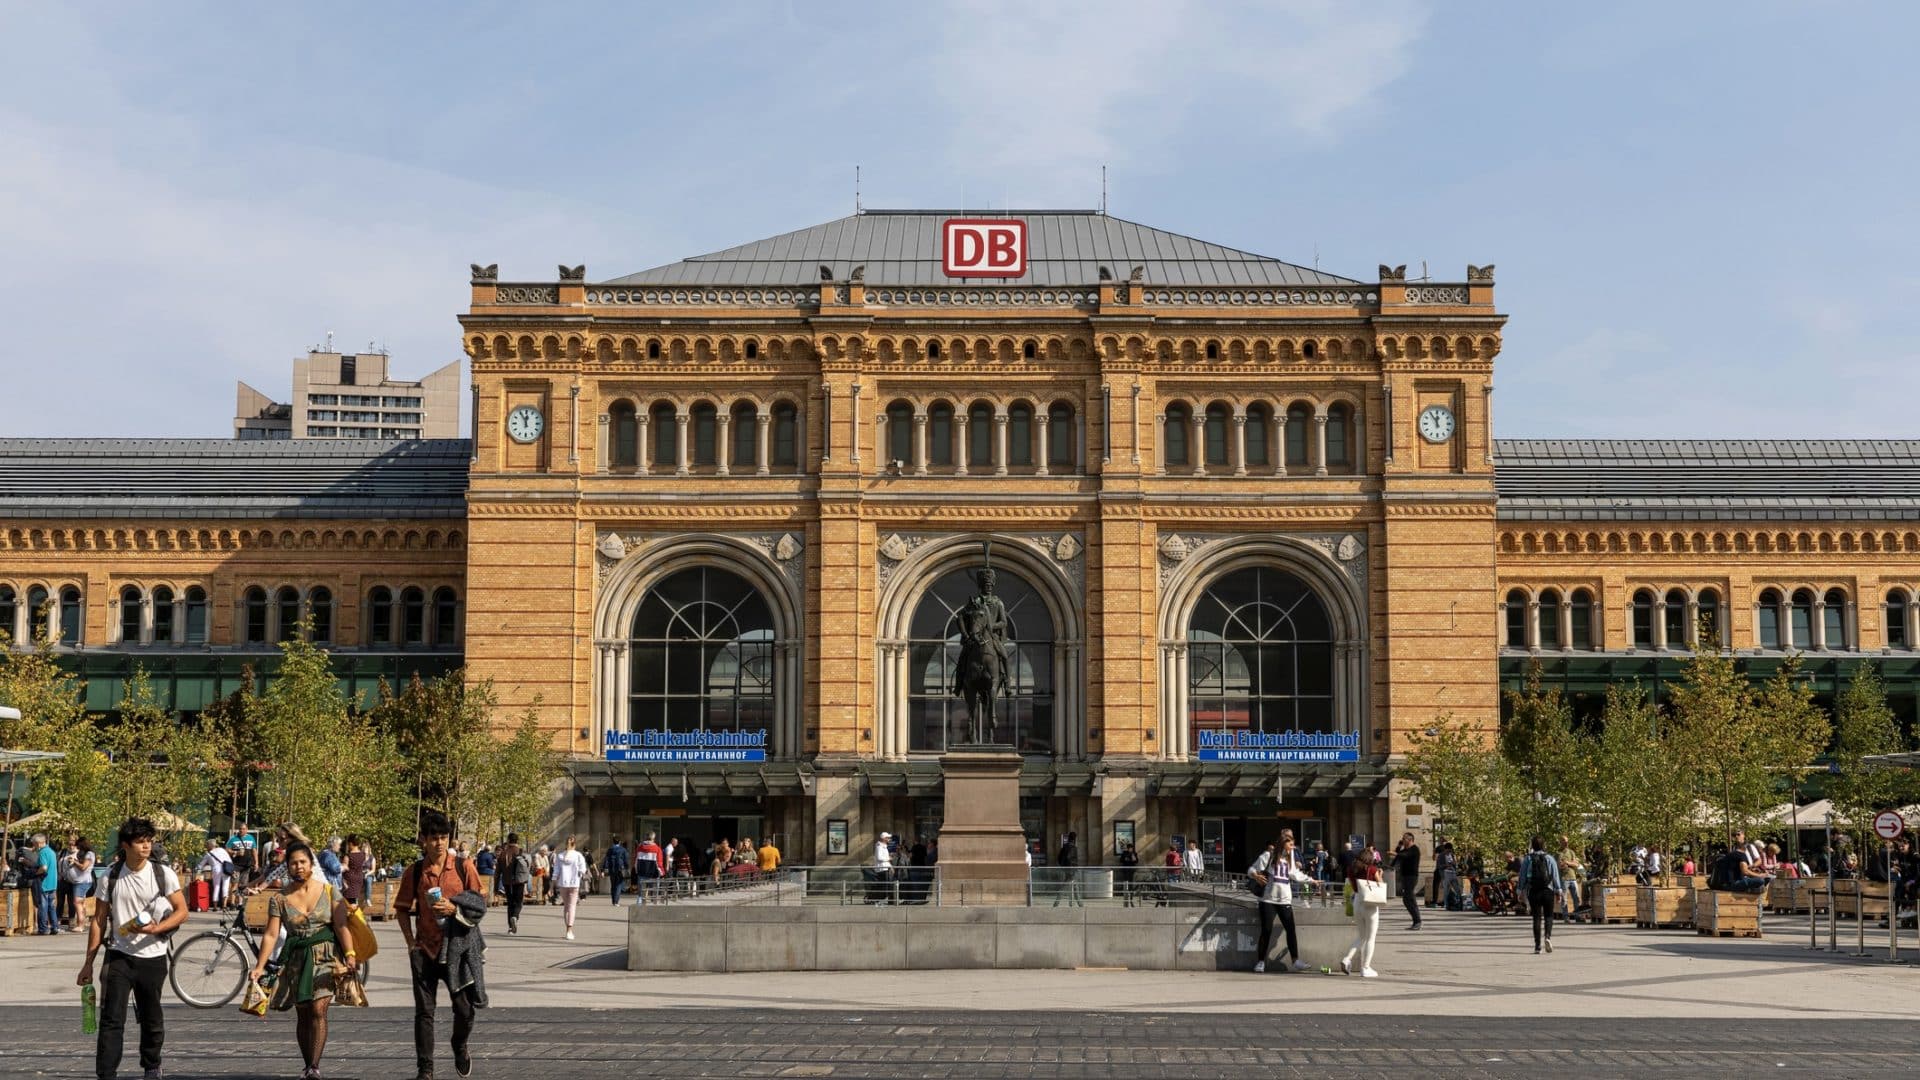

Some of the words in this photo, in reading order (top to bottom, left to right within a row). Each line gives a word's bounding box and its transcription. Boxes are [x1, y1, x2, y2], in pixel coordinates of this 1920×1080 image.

[954, 229, 1017, 267] DB
[606, 729, 640, 745] Mein
[644, 729, 765, 746] Einkaufsbahnhof
[1199, 730, 1233, 746] Mein
[1237, 730, 1358, 747] Einkaufsbahnhof
[624, 751, 672, 760] HANNOVER
[675, 751, 747, 760] HAUPTBAHNHOF
[1217, 751, 1265, 760] HANNOVER
[1269, 751, 1340, 760] HAUPTBAHNHOF
